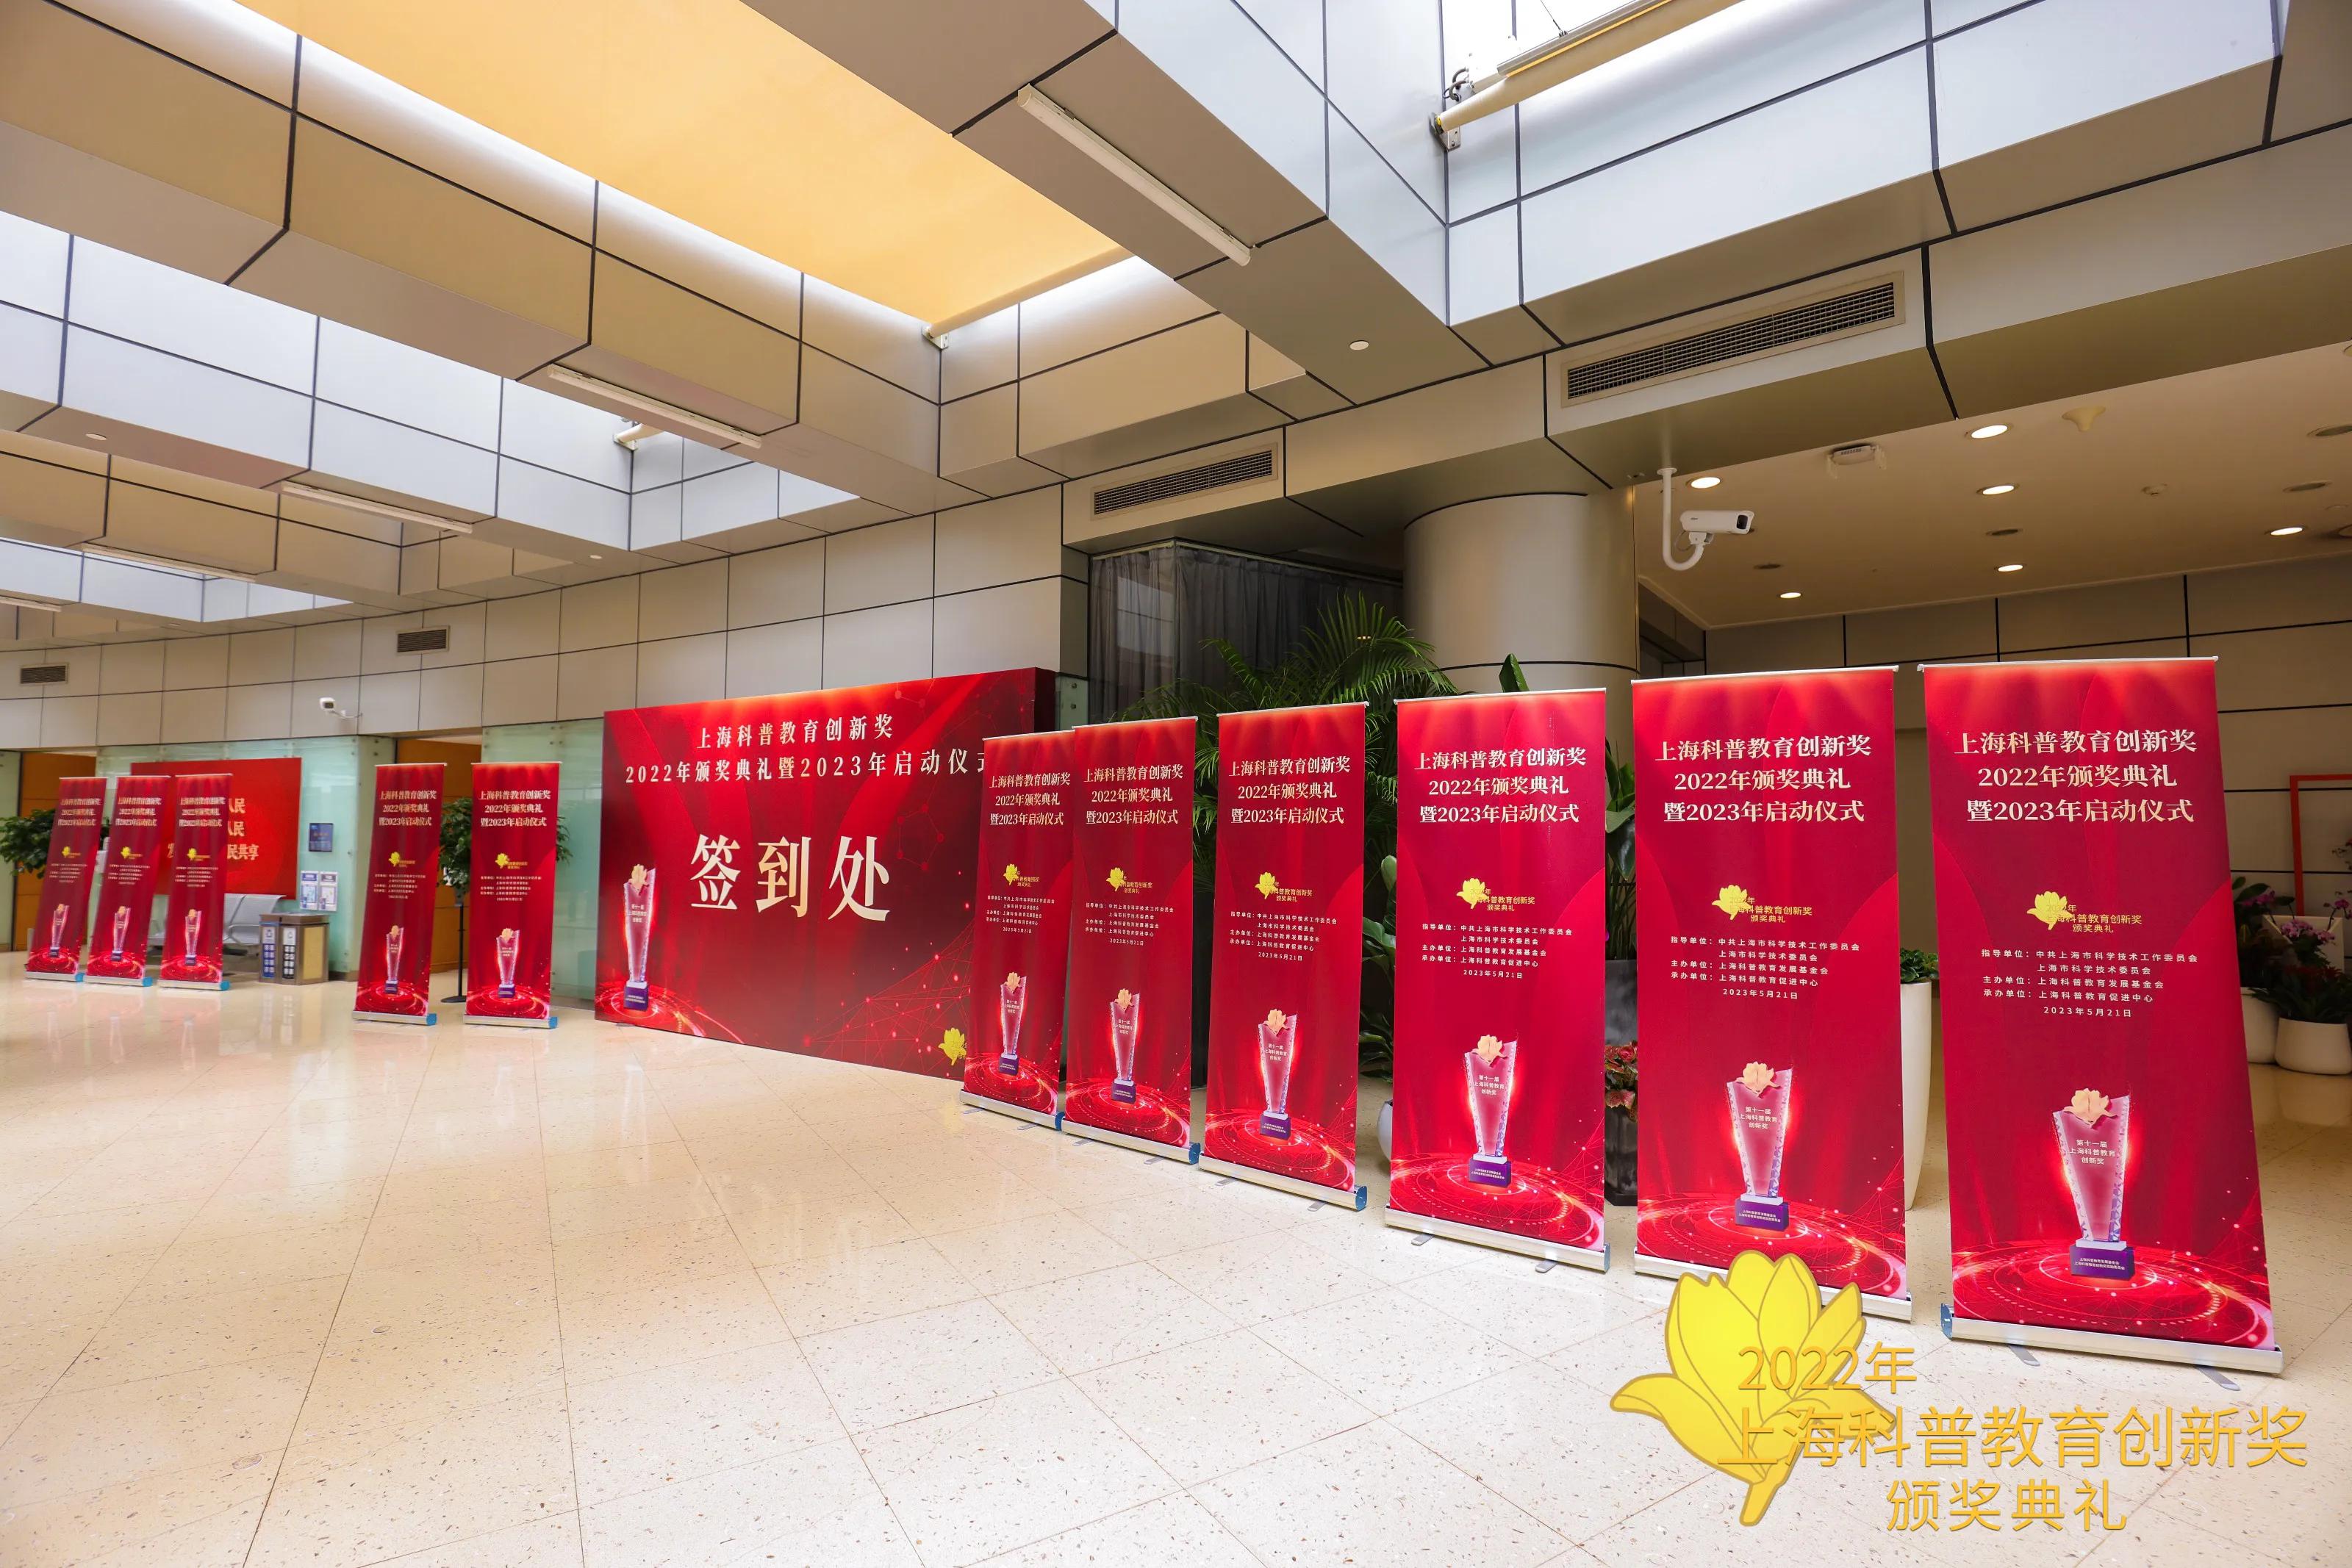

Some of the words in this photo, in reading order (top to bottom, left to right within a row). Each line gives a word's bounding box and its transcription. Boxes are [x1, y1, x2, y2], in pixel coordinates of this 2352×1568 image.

[696, 713, 893, 749] 上海科普教育创新奖
[1654, 734, 1871, 762] 上海科普教育创新奖
[1954, 729, 2198, 756] 上海科普教育创新奖
[1228, 755, 1351, 777] 上海科普教育创新奖
[1414, 747, 1587, 771] 上海科普教育创新奖
[989, 772, 1071, 788] 上海科普教育创新奖
[1083, 764, 1183, 783] 上海科普教育创新奖
[1674, 768, 1851, 791] 2022年颁奖典礼
[1978, 766, 2178, 788] 2022年颁奖典礼
[1238, 781, 1337, 799] 2022年颁奖典礼
[1428, 774, 1569, 795] 2022年颁奖典礼
[478, 790, 551, 800] 上海科普教育创新奖
[995, 793, 1061, 807] 2022年颁奖典礼
[1091, 787, 1173, 803] 2022年颁奖典礼
[484, 804, 544, 813] 2022年颁奖典礼
[1230, 806, 1344, 824] 暨2023年启动仪式
[1419, 804, 1580, 824] 暨2023年启动仪式
[1663, 800, 1865, 824] 暨2023年启动仪式
[1966, 799, 2195, 824] 暨2023年启动仪式
[989, 812, 1064, 827] 暨2023年启动仪式
[1086, 809, 1178, 825] 暨2023年启动仪式
[689, 833, 891, 921] 签到处
[1750, 914, 1786, 923] 颁奖典礼
[2072, 924, 2114, 933] 颁奖典礼
[1670, 935, 1860, 952] 指导单位：中共上海市科学技术工作委员会
[1258, 952, 1302, 961] 2023年5月21日
[1718, 950, 1818, 962] 上海市科学技术委员会
[1981, 949, 2198, 963] 指导单位：中共上海市科学技术工作委员会
[1463, 969, 1523, 979] 2023年5月21日
[1671, 960, 1829, 975] 主办单位：上海科普教育发展基金会
[2037, 963, 2151, 975] 上海市科学技术委员会
[1671, 971, 1818, 987] 承办单位：上海科普教育促进中心
[1982, 976, 2165, 989] 主办单位：上海科普教育发展基金会
[1722, 988, 1799, 999] 2023年5月21日
[1983, 988, 2154, 1003] 承办单位：上海科普教育促进中心
[2043, 1006, 2132, 1018] 2023年5月21日
